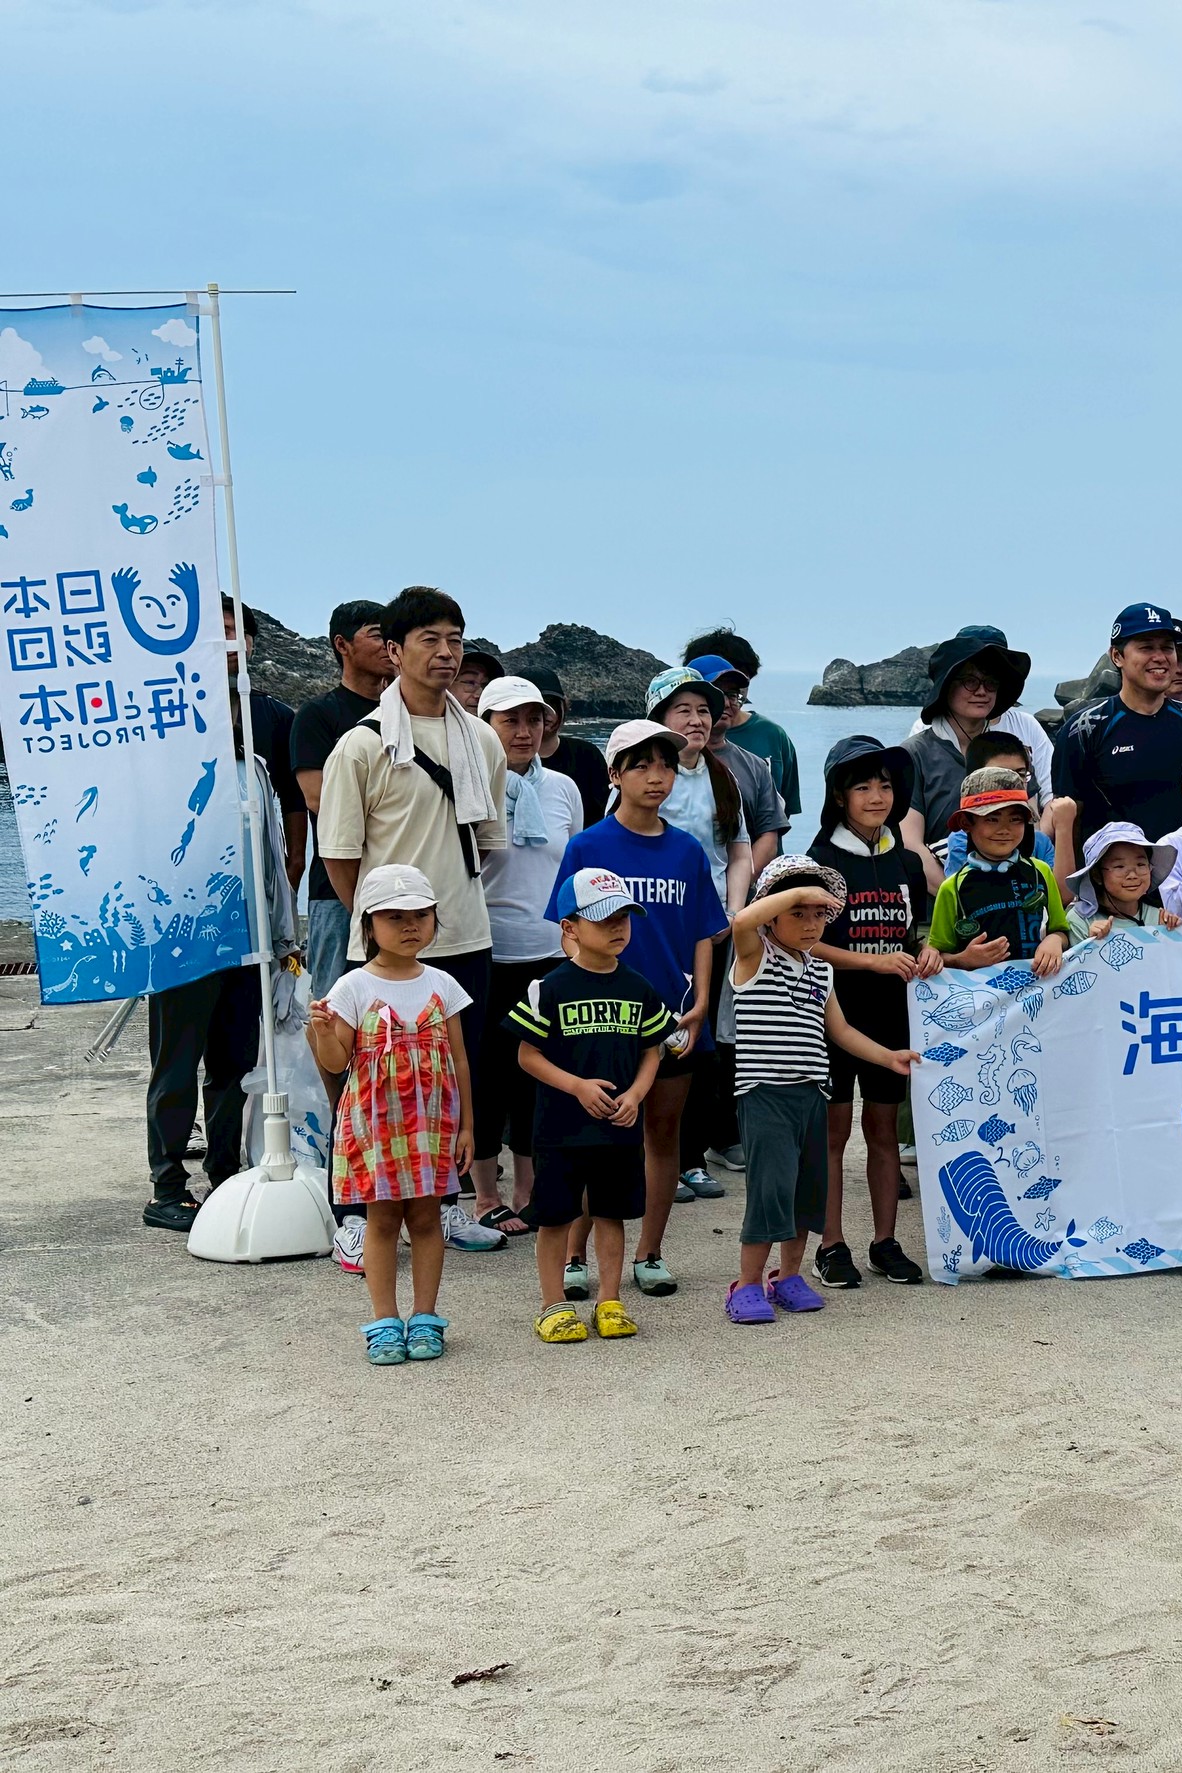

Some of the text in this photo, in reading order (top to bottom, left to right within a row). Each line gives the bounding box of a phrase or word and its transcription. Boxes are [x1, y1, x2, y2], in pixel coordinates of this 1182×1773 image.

[1144, 607, 1162, 623] LA
[620, 876, 687, 906] TTERFLY
[849, 904, 906, 922] umbro
[848, 922, 907, 938] umbro
[562, 1001, 641, 1027] CORN.H
